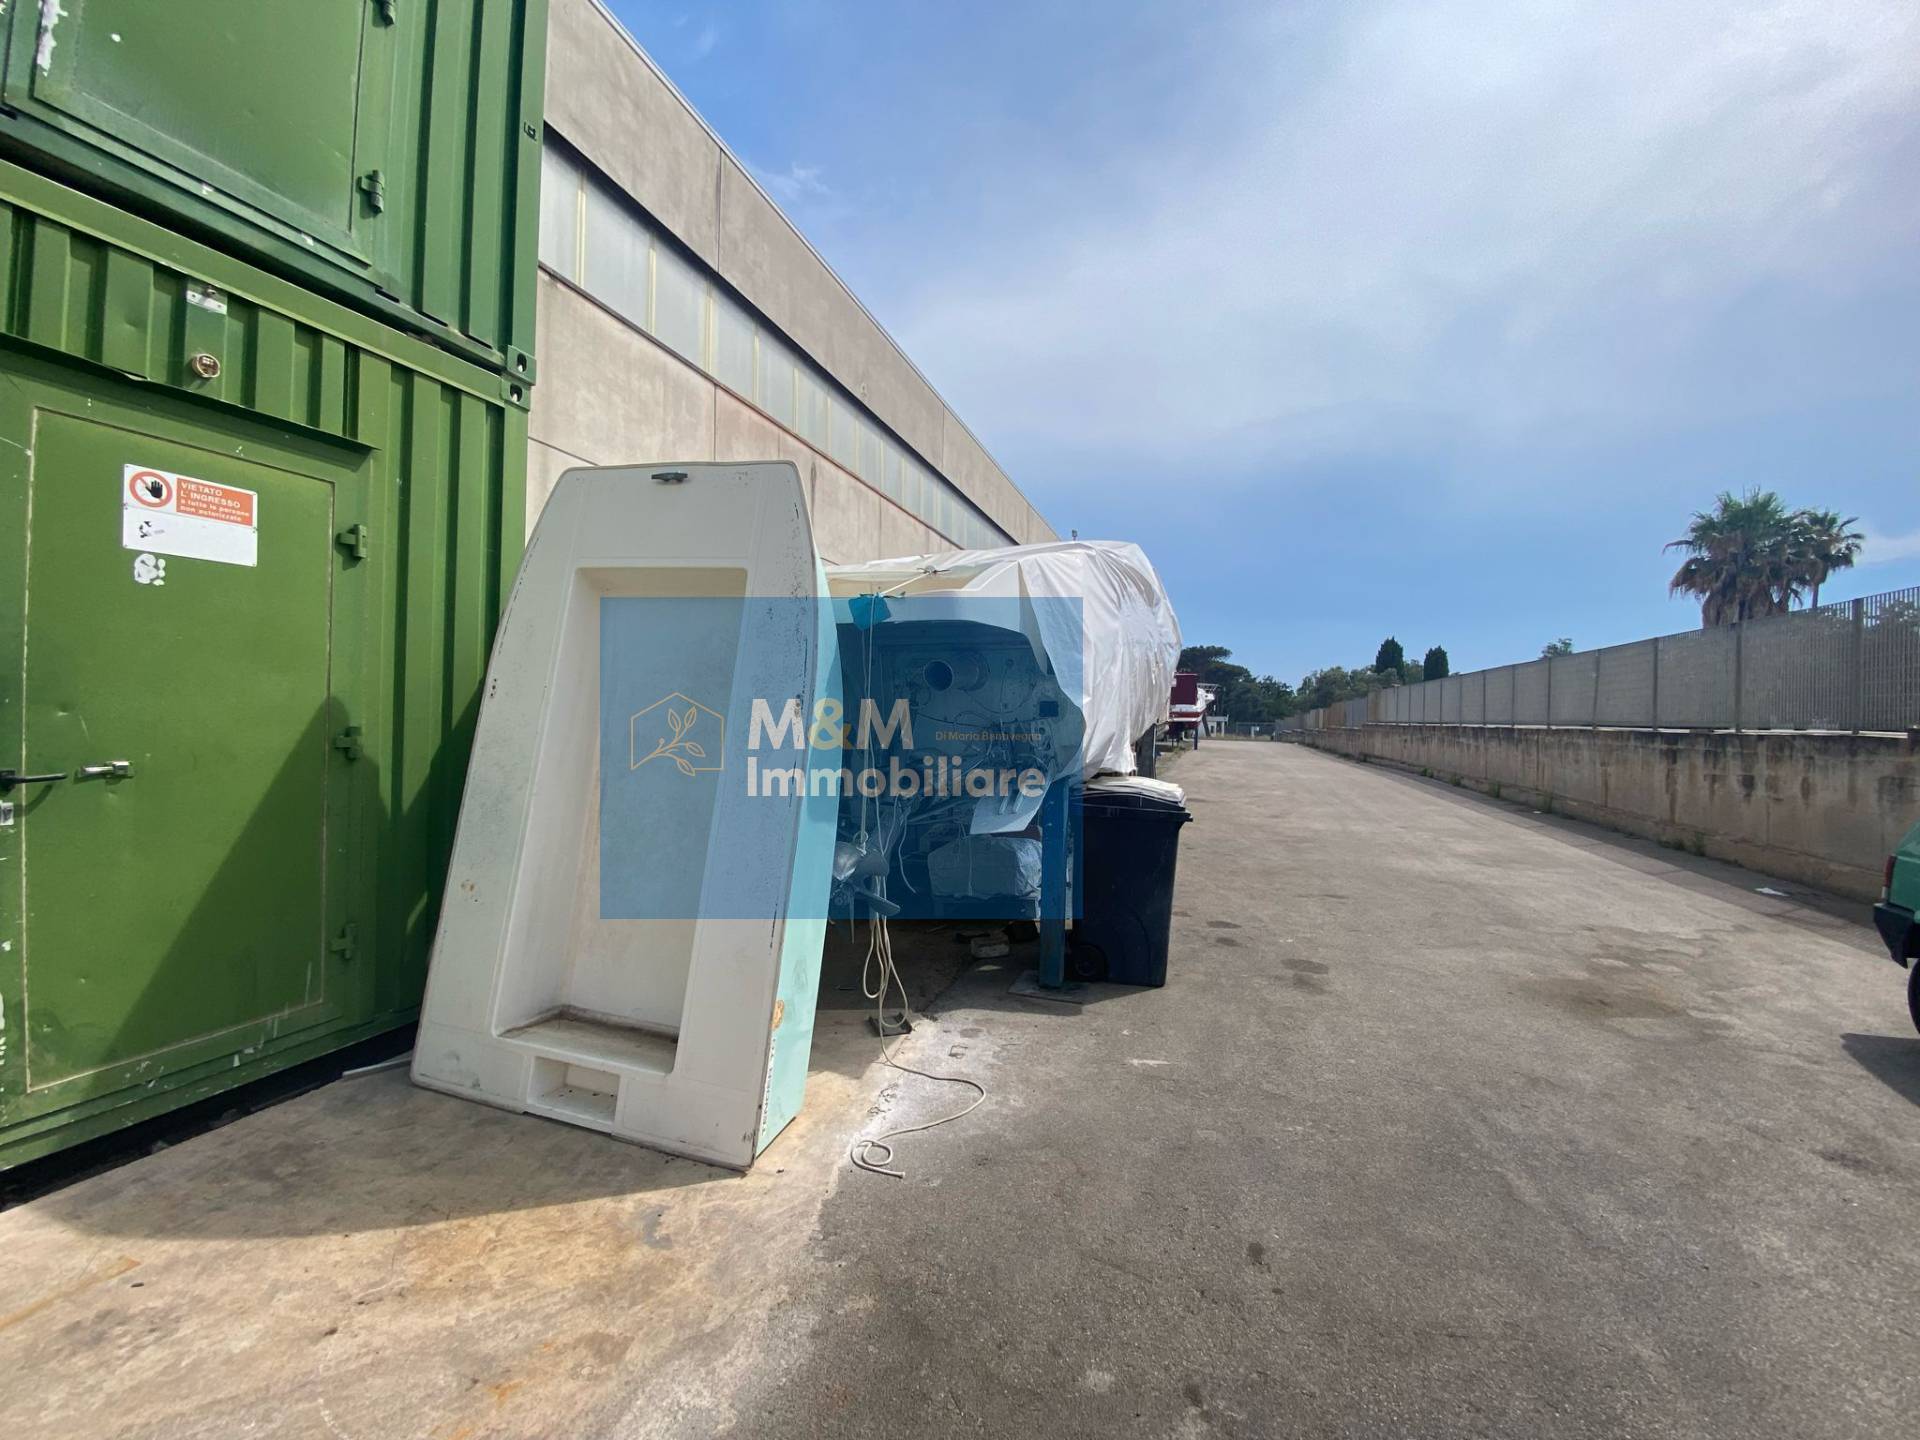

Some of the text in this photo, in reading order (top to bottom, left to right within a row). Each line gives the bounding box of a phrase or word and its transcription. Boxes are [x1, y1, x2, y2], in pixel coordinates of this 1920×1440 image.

[181, 482, 223, 496] VIETATO
[190, 492, 241, 508] INGRESSO
[219, 506, 250, 517] persone
